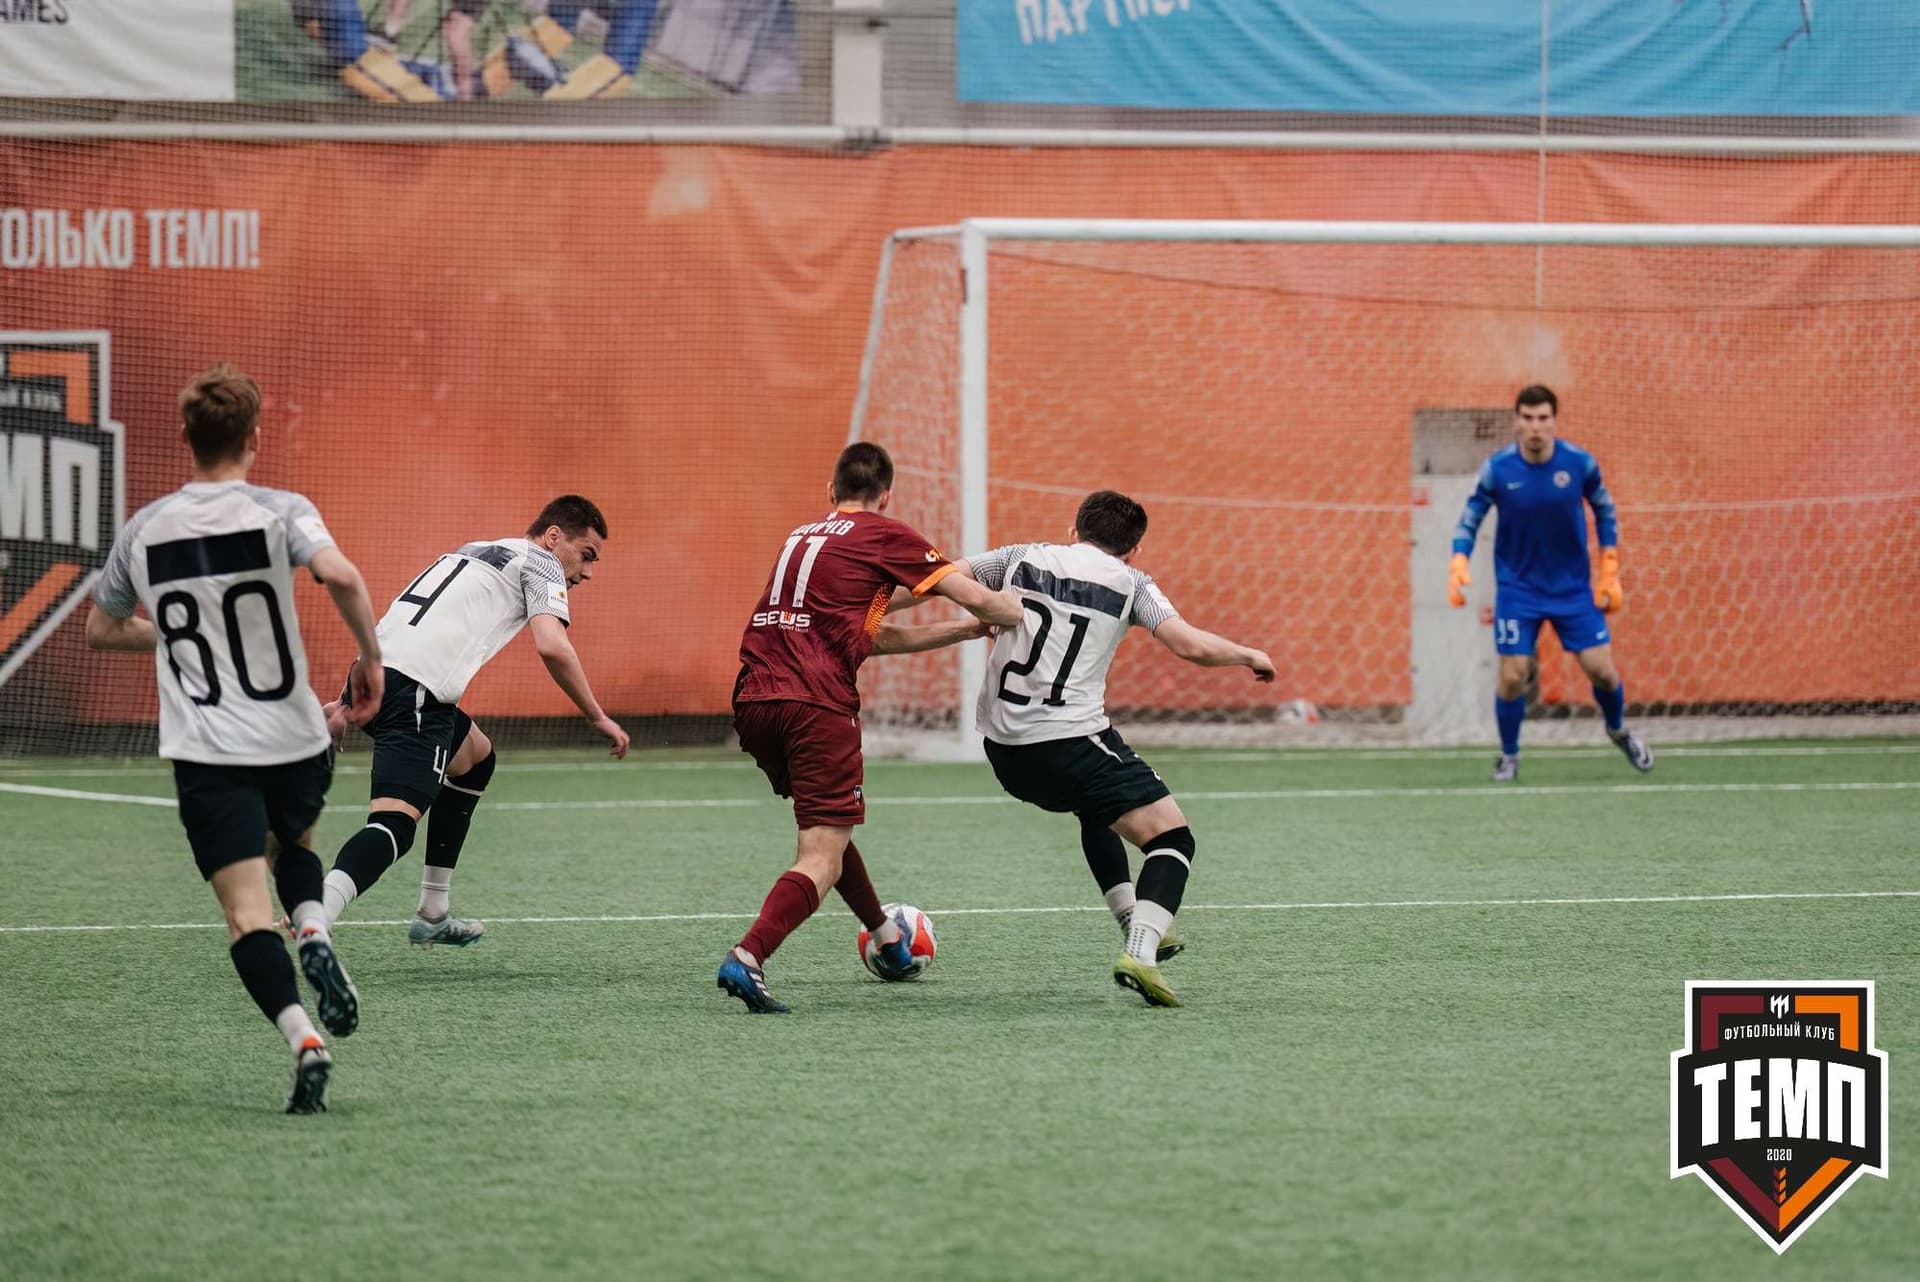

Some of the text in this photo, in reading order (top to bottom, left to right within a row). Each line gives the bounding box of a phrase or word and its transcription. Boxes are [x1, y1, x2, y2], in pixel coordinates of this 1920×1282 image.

[0, 208, 260, 269] ОЛЬКО ТЕМП!
[397, 555, 470, 627] 4
[768, 535, 829, 609] 11
[156, 579, 296, 707] 80
[997, 597, 1091, 707] 21
[432, 744, 449, 785] 4
